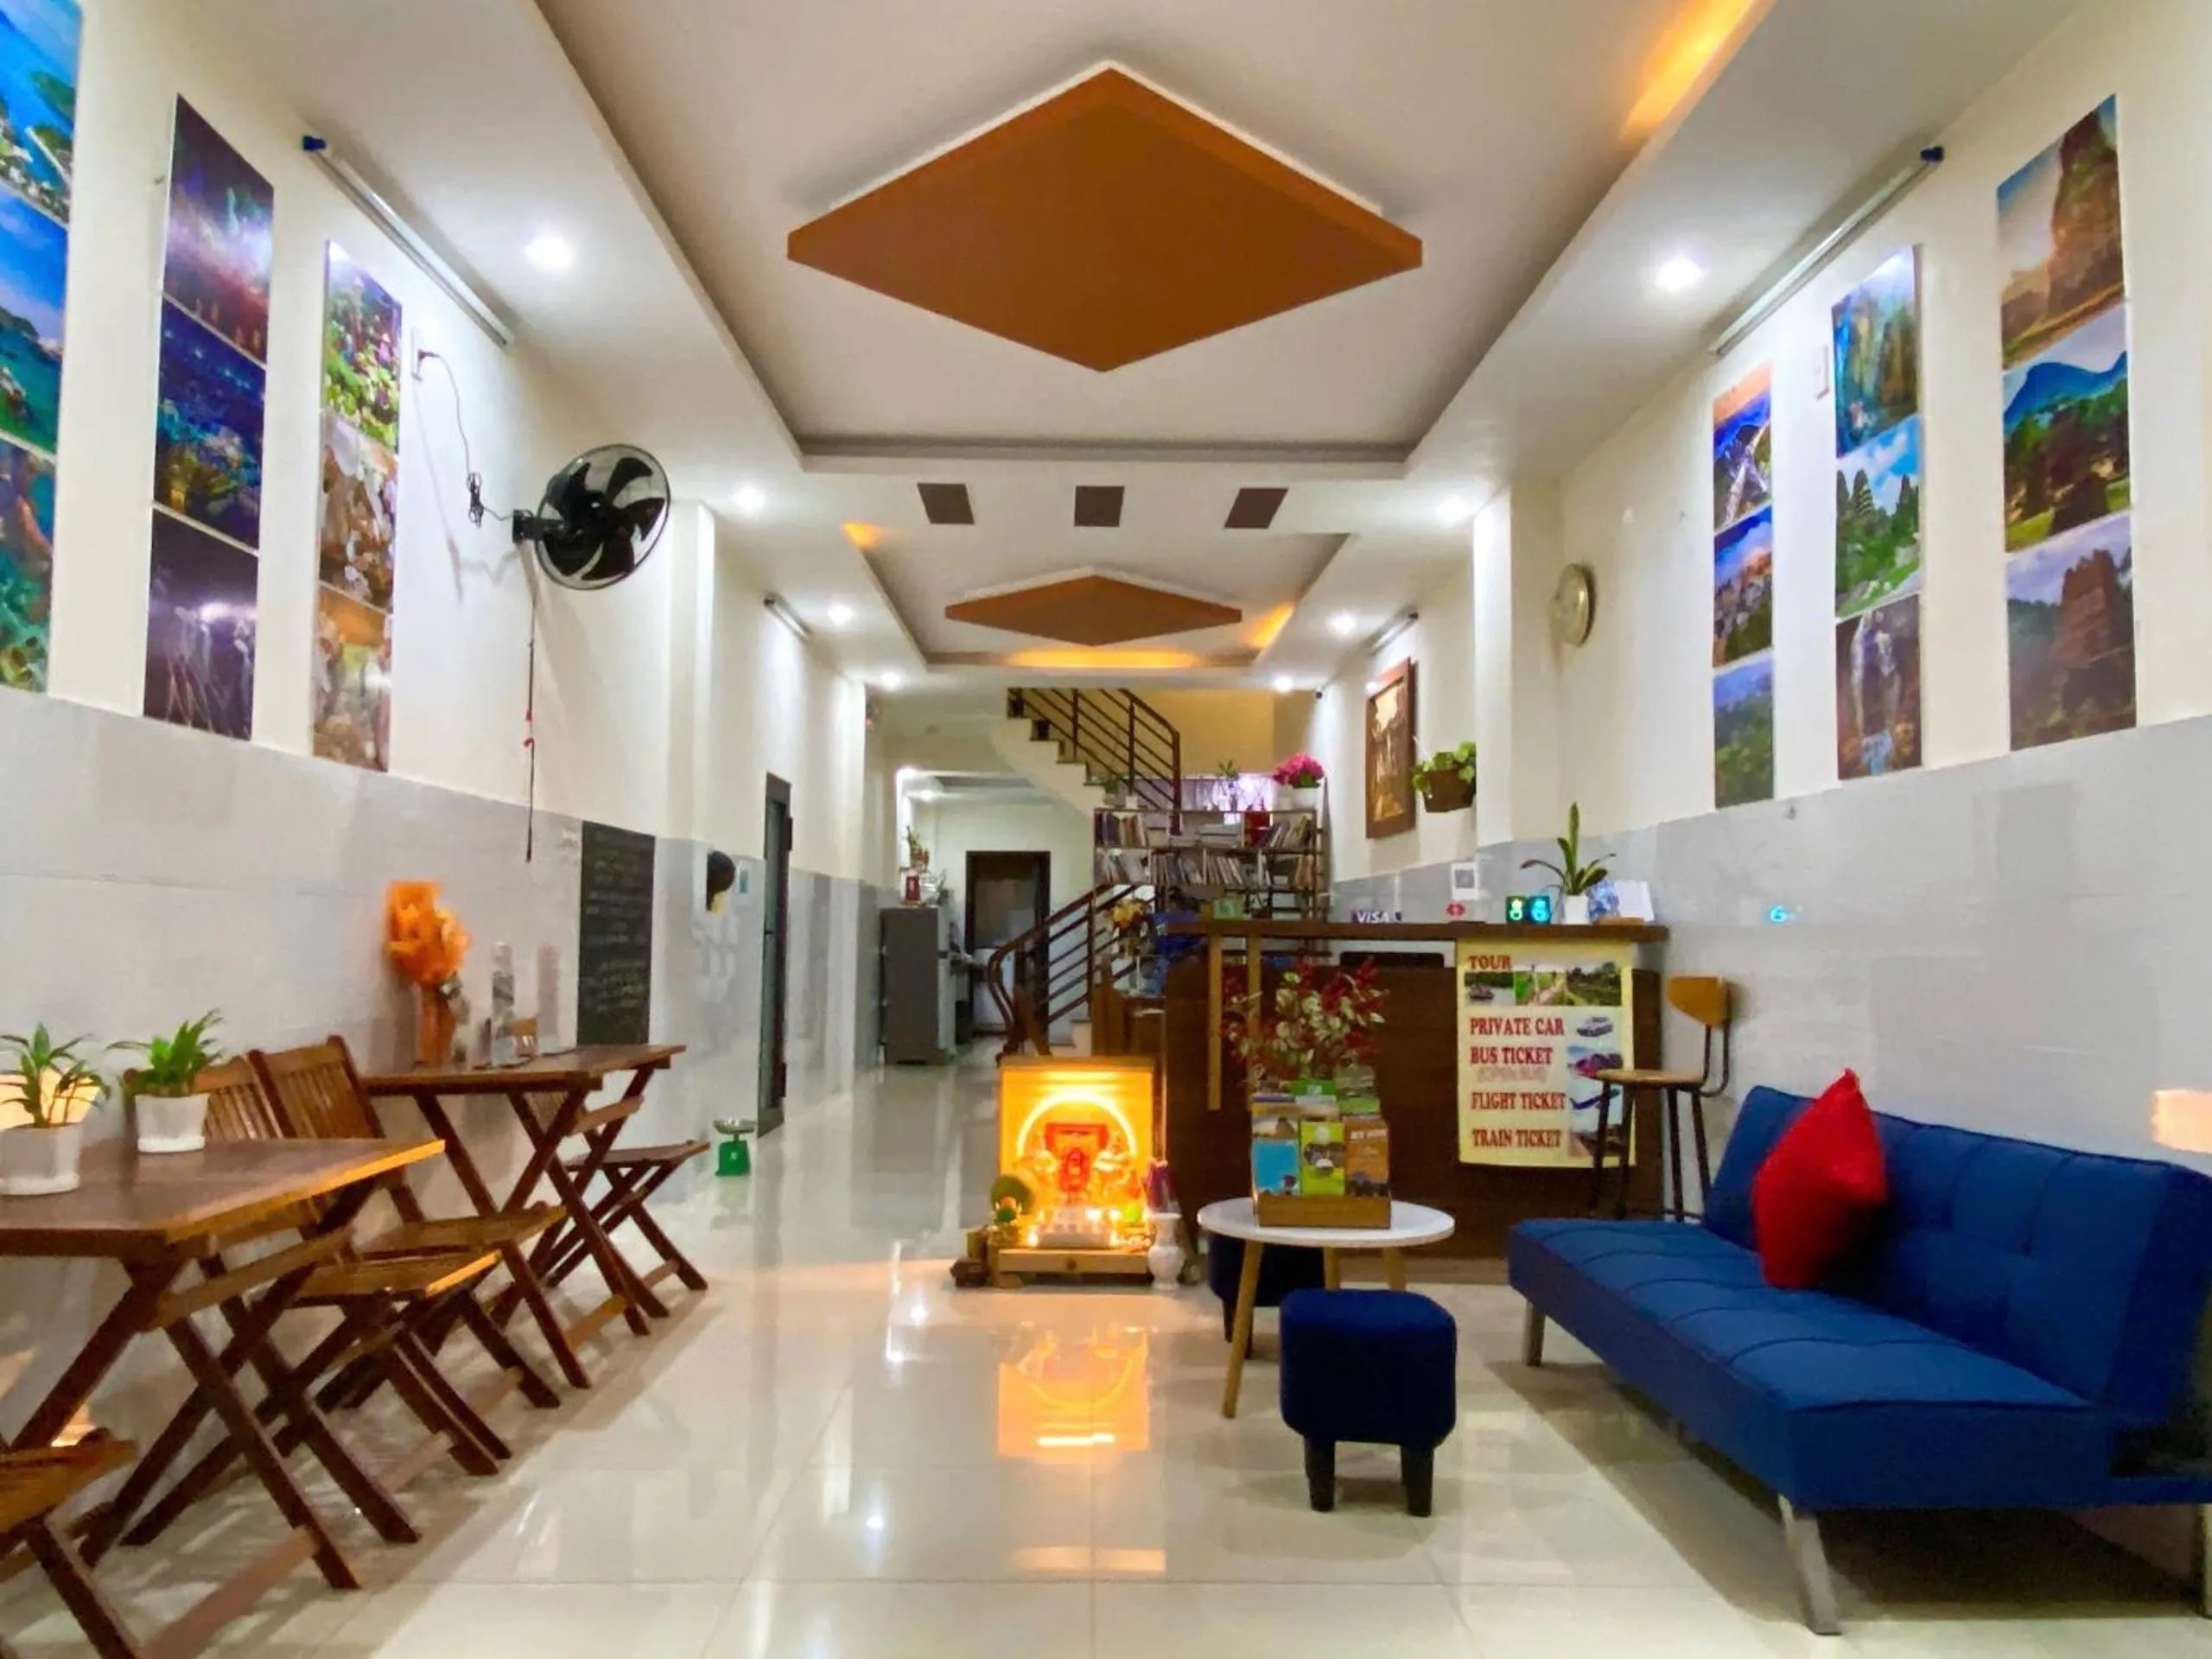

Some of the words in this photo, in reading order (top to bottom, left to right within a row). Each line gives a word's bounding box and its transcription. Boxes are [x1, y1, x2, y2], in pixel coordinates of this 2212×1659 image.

[1356, 912, 1389, 924] VISA
[1469, 955, 1511, 969] TOUR
[1471, 1018, 1530, 1036] PRIVATE
[1535, 1018, 1564, 1036] CAR
[1471, 1046, 1497, 1065] BUS
[1502, 1046, 1553, 1065] TICKET
[1471, 1092, 1516, 1109] FLIGHT
[1521, 1092, 1566, 1110] TICKET
[1472, 1129, 1511, 1147] TRAIN
[1516, 1129, 1560, 1147] TICKET
